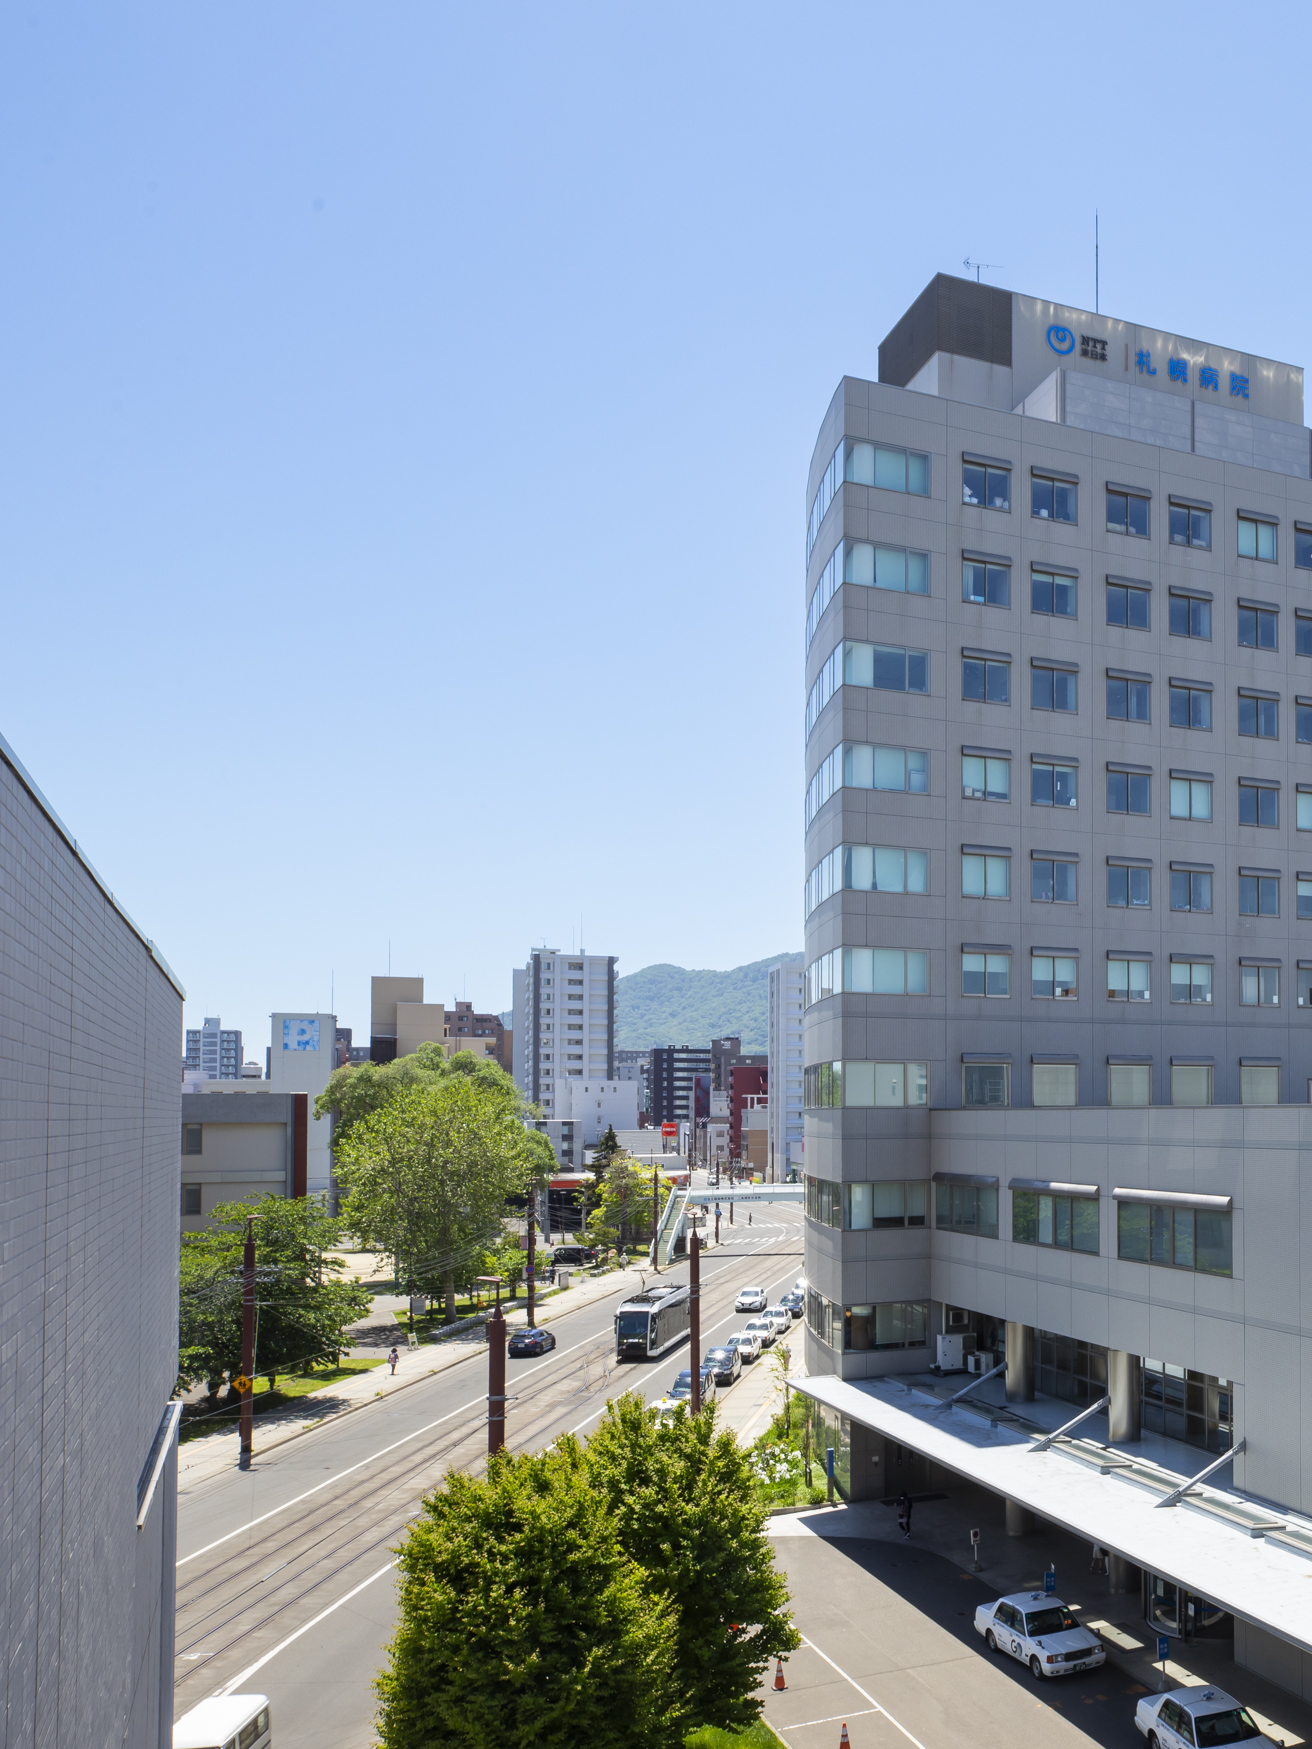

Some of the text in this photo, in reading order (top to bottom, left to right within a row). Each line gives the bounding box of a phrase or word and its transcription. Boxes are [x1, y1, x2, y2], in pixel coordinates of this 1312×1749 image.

[1081, 335, 1108, 351] NTT
[1081, 347, 1108, 361] 東日本
[1137, 350, 1250, 398] 札幌病院
[289, 1021, 314, 1050] P
